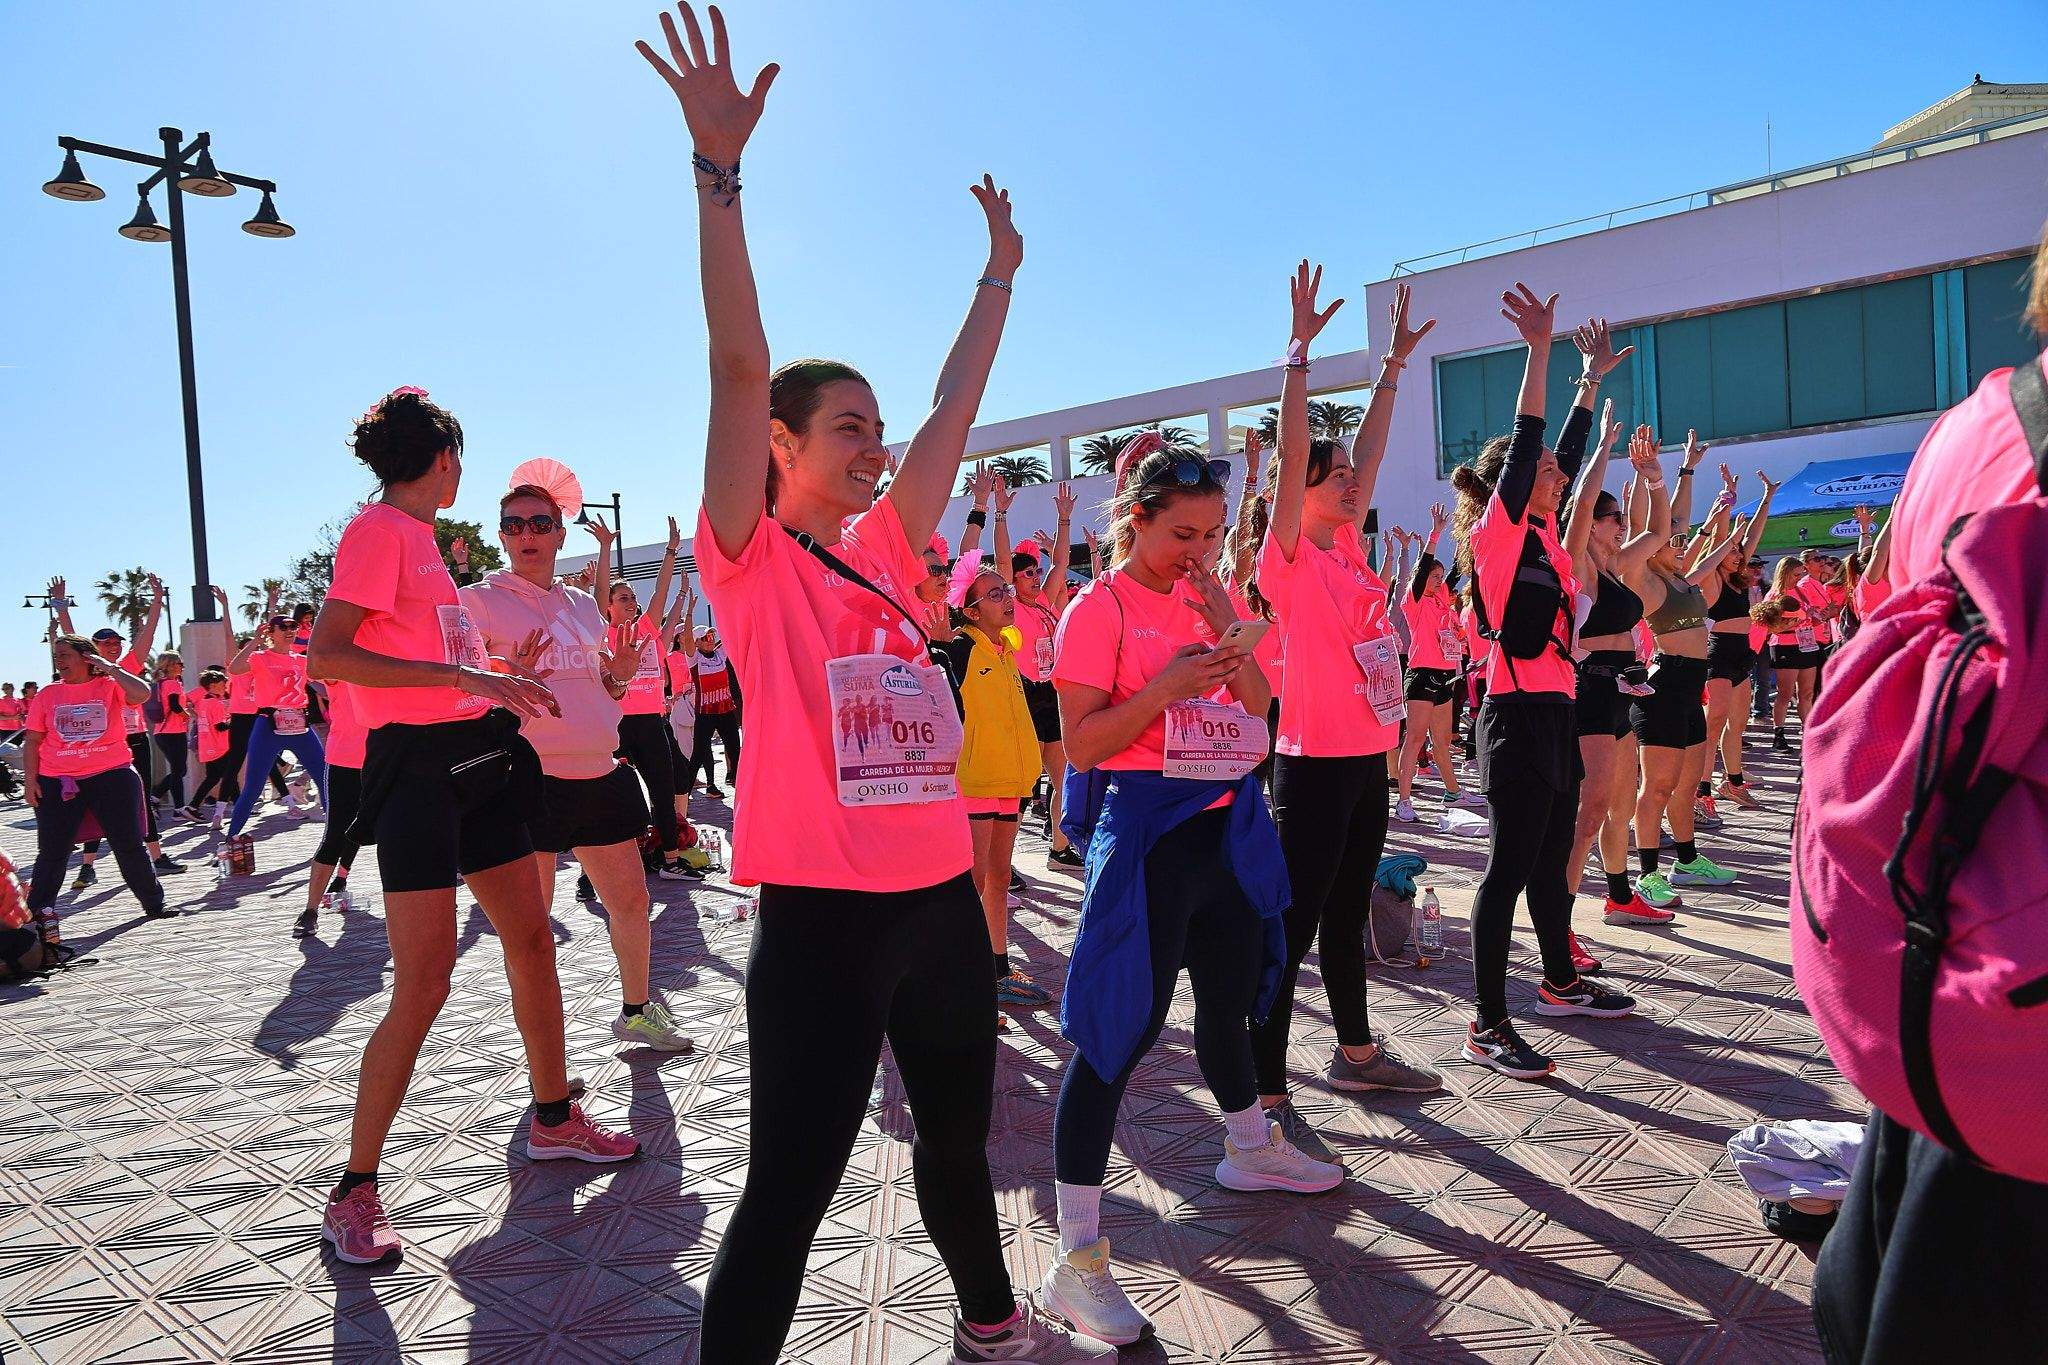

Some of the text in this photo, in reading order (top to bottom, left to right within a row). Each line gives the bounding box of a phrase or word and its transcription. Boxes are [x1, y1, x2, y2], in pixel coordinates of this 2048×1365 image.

[844, 680, 875, 691] SUMA
[72, 720, 91, 728] 016
[1202, 720, 1241, 739] 016
[892, 720, 935, 744] 016
[904, 750, 926, 761] 8837
[860, 767, 894, 777] CARRERA
[895, 766, 905, 774] DE
[906, 765, 915, 773] LA
[915, 764, 934, 773] MUJER
[1178, 763, 1216, 774] OYSHO
[857, 781, 909, 797] OYSHO
